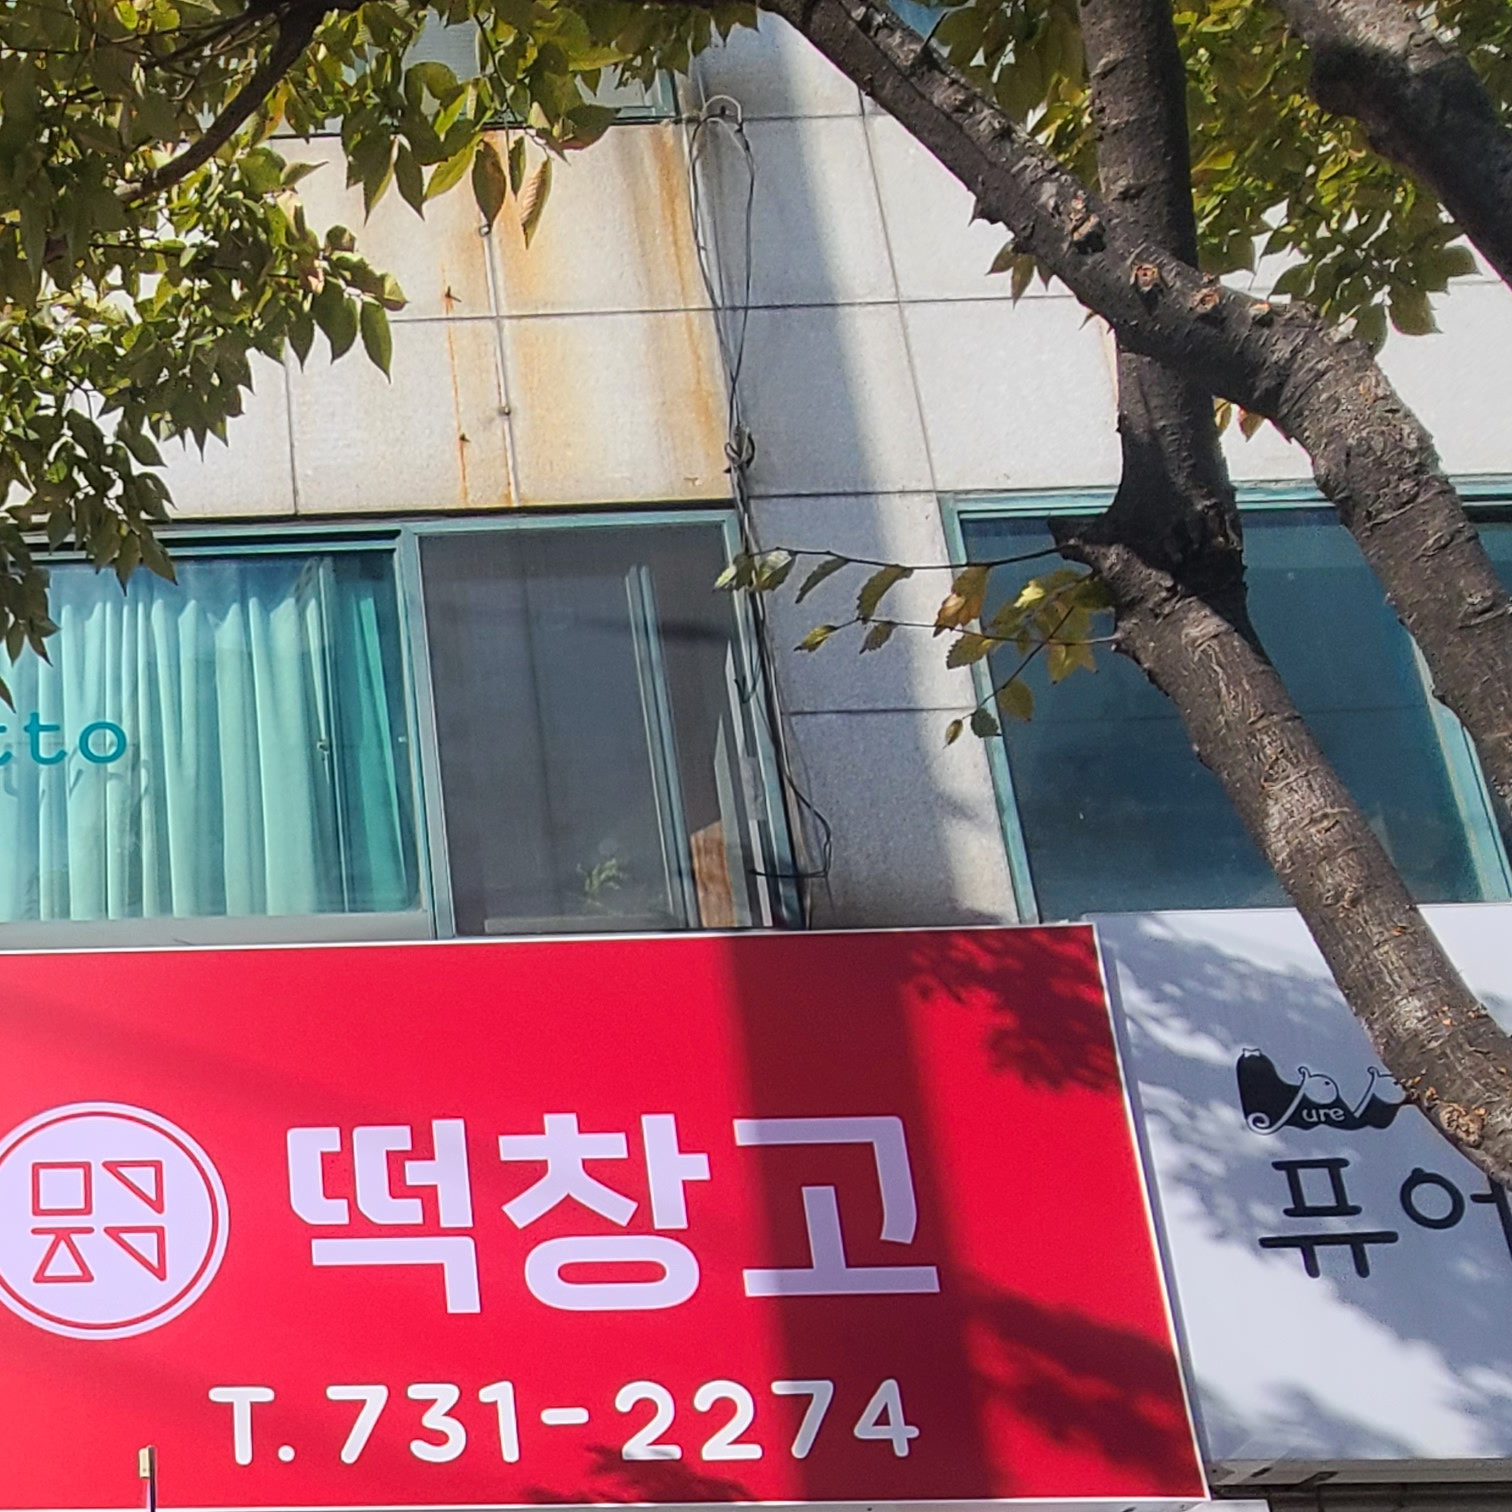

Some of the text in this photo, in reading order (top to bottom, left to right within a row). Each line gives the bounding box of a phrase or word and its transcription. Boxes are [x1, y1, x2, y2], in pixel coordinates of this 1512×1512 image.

[286, 1112, 941, 1315] 떡창고
[208, 1378, 921, 1466] T. 731-2274
